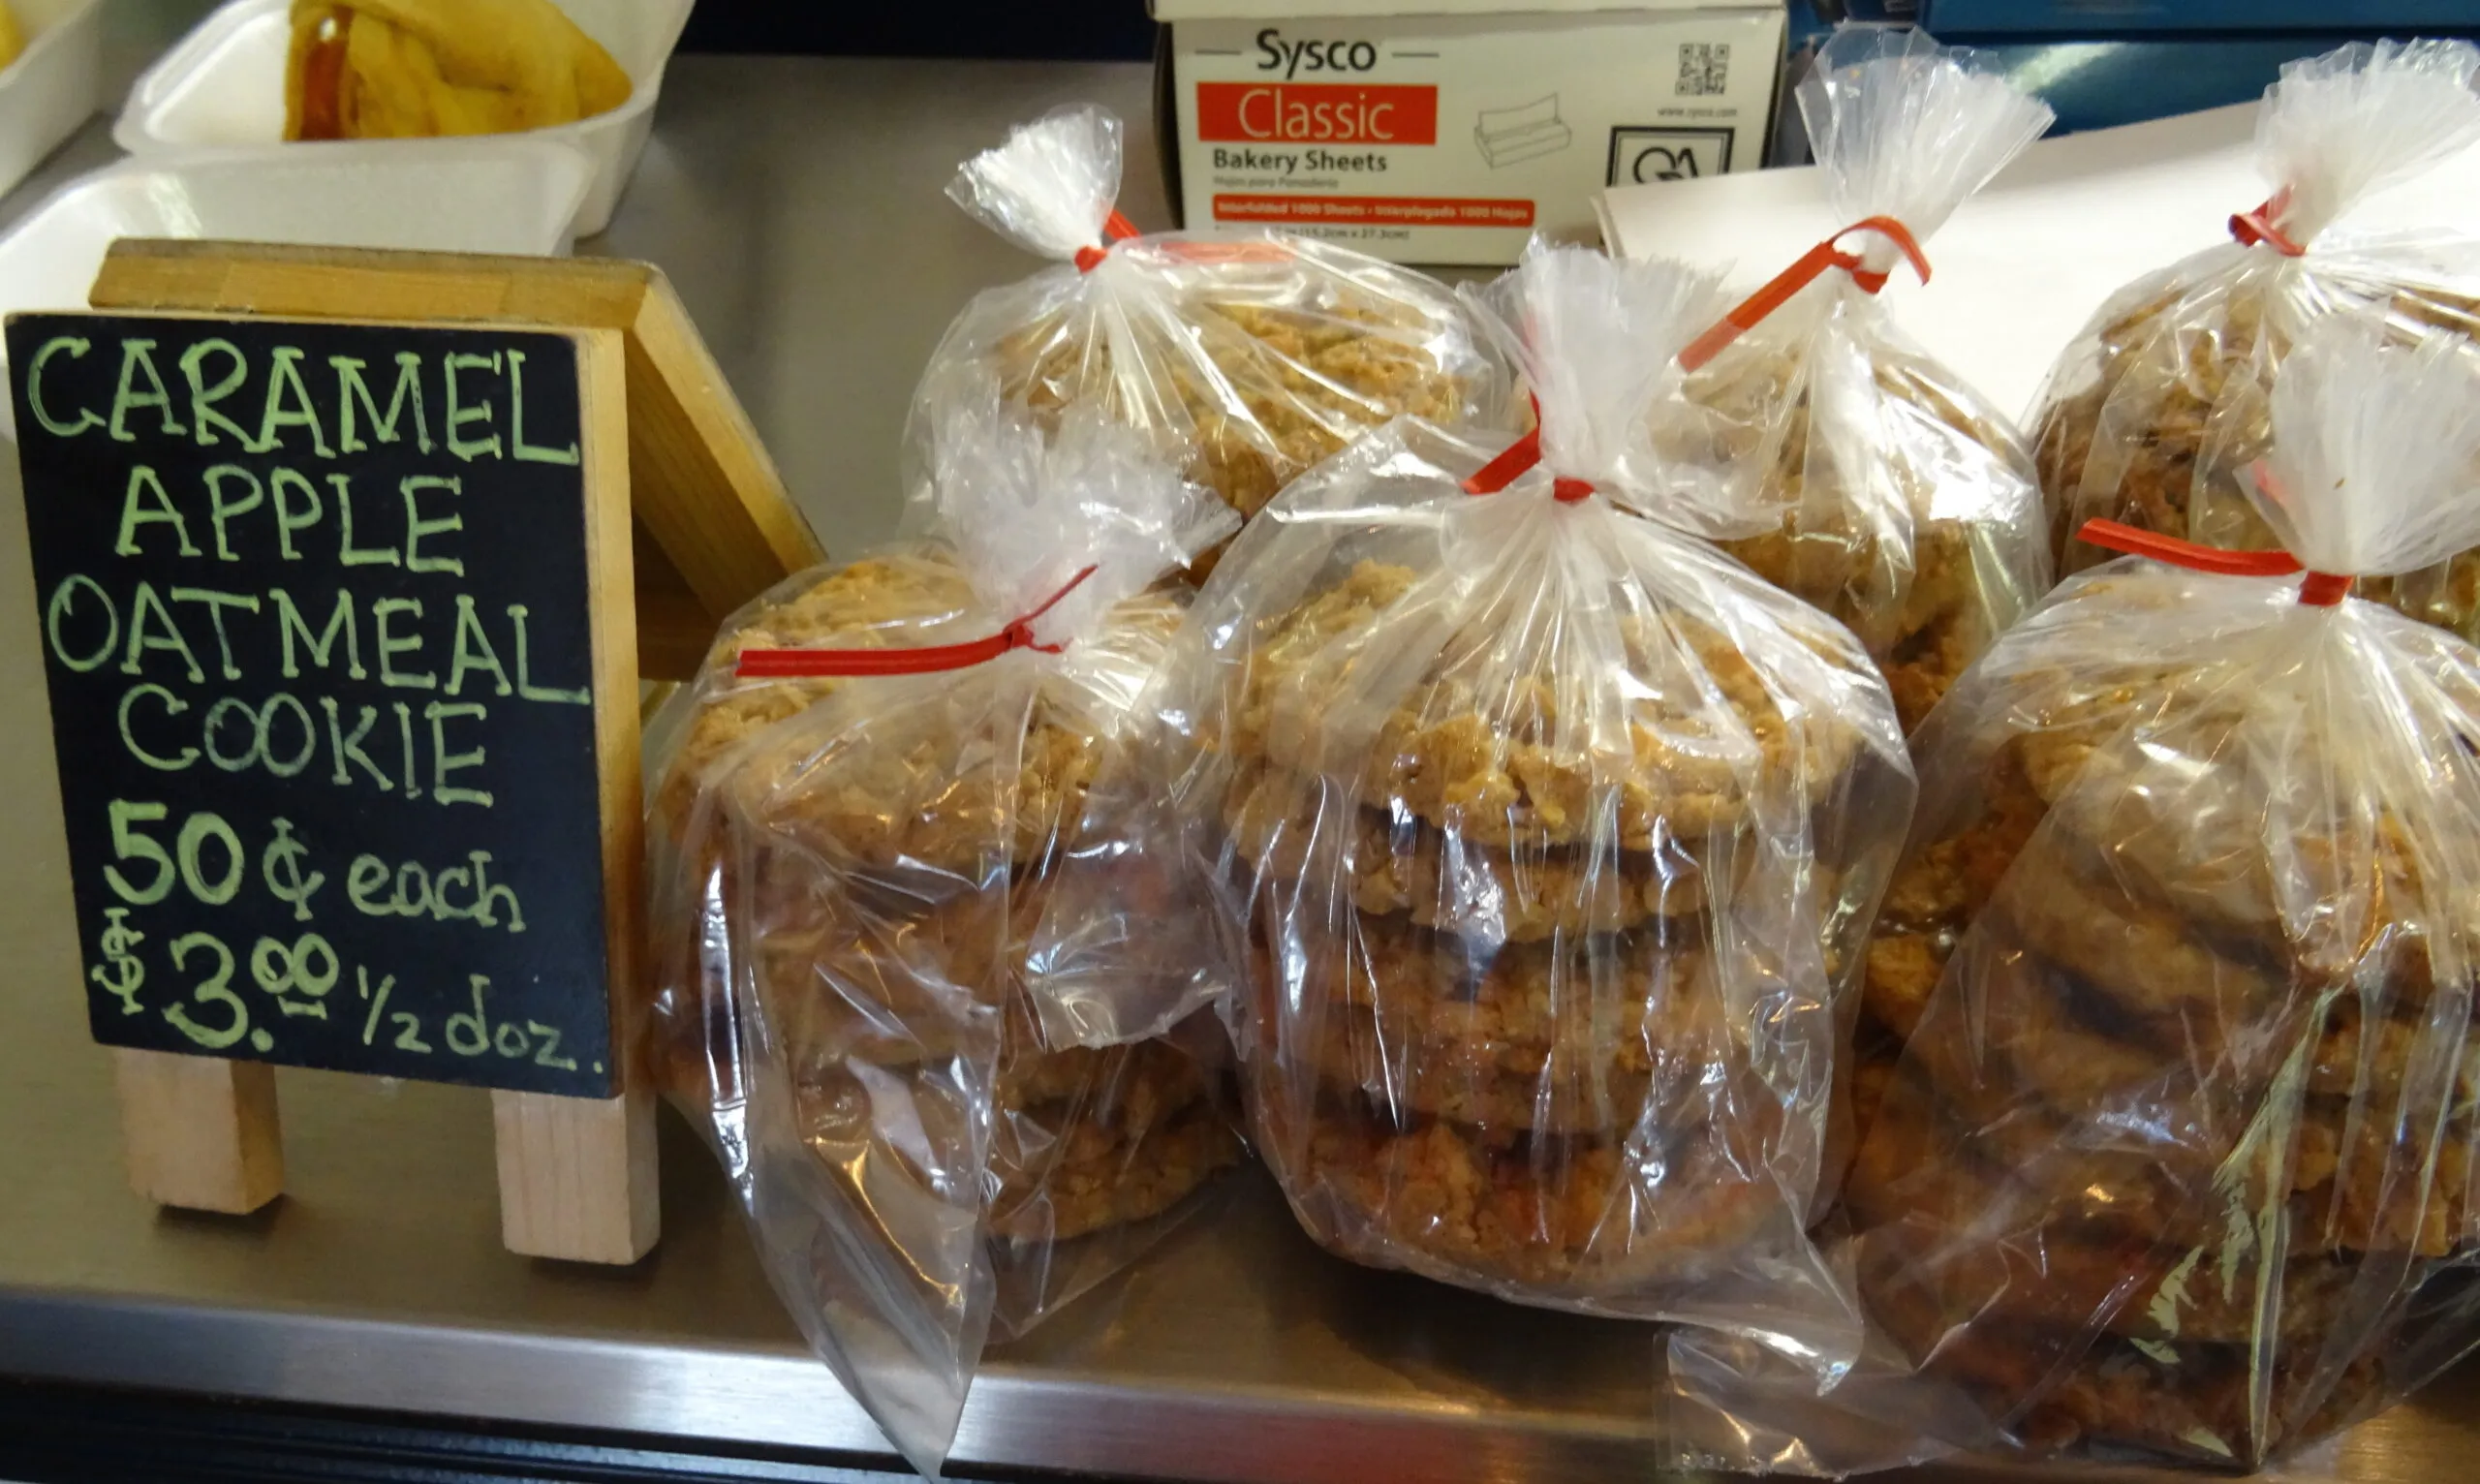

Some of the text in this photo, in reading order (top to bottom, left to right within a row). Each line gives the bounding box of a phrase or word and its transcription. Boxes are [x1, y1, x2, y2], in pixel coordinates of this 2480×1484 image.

[1256, 27, 1377, 80] Sysco
[1214, 148, 1387, 174] Bakery Sheets
[1238, 87, 1395, 140] Classic
[28, 336, 580, 464] CARAMEL
[115, 465, 465, 577] APPLE
[48, 573, 592, 705] OATMEAL
[118, 683, 494, 806] COOKIE
[347, 850, 527, 934] each
[446, 974, 604, 1074] doz.
